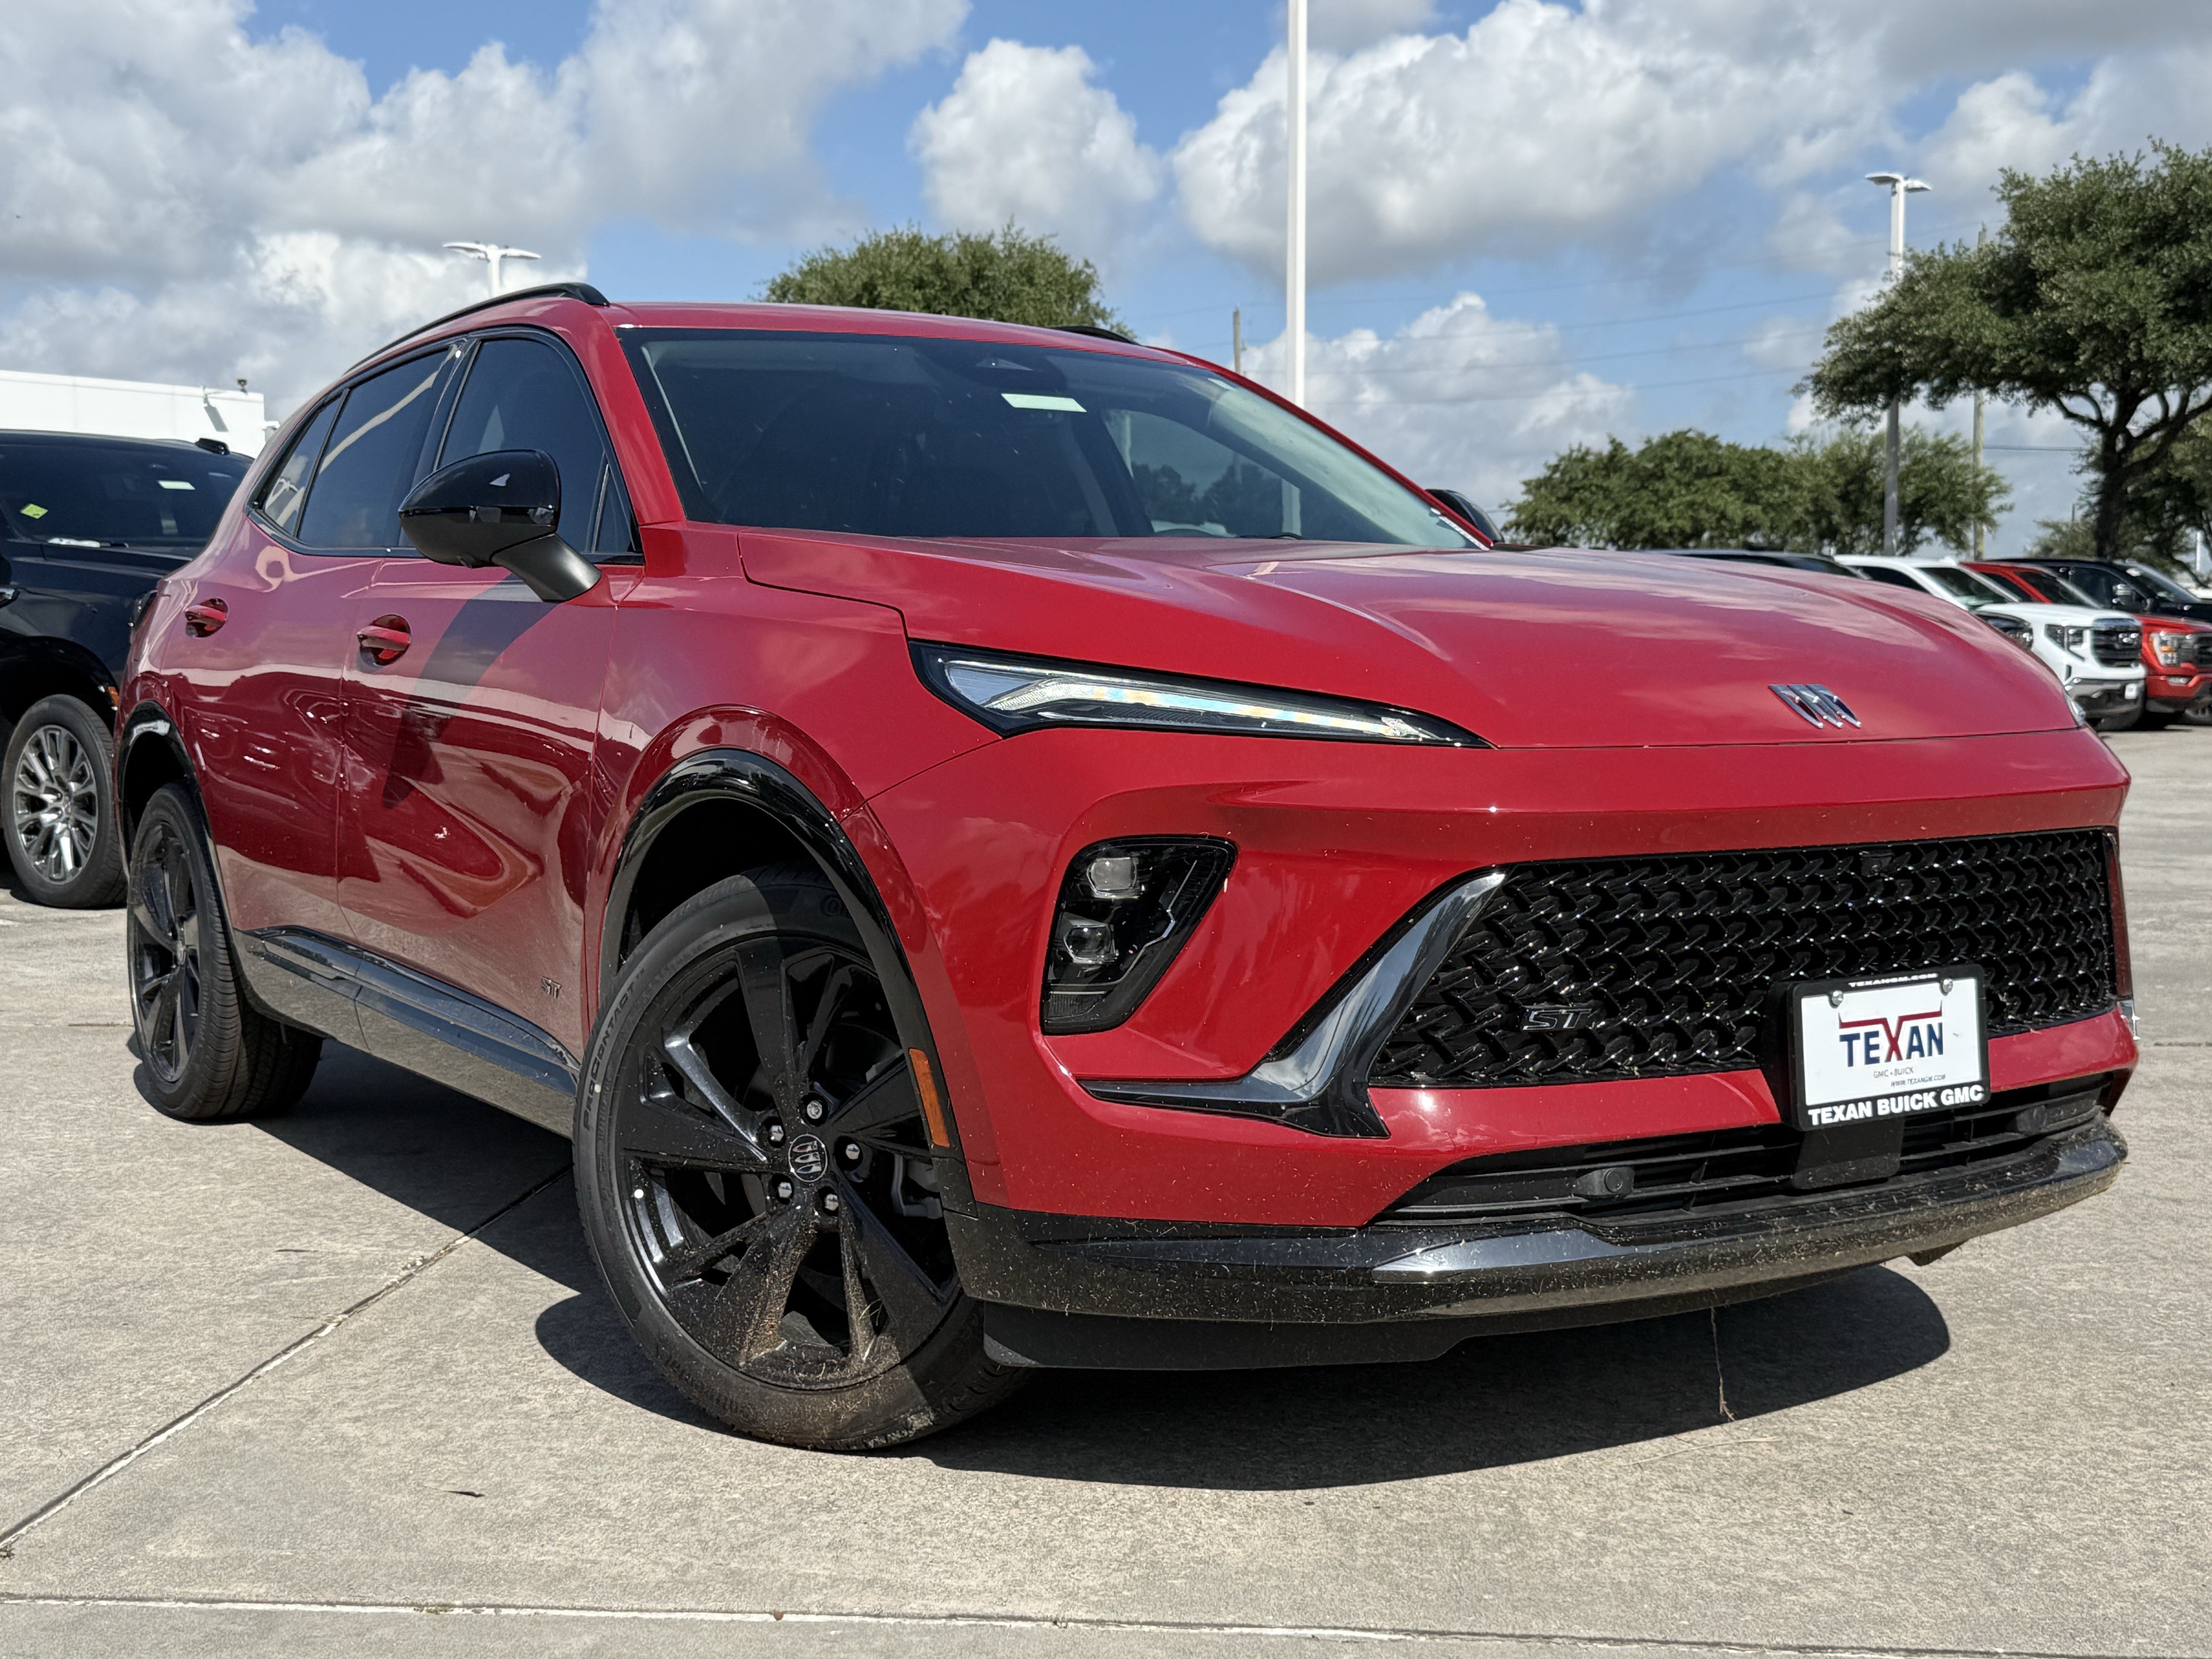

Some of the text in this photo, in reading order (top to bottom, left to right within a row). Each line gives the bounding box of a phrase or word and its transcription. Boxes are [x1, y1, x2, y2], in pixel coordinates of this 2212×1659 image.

[1848, 973, 1938, 987] TEXANGM.COM
[1523, 1008, 1592, 1030] ST
[1838, 1015, 1944, 1067] TEXAN
[1873, 1067, 1914, 1078] GMC BUICK
[1808, 1084, 1984, 1125] TEXAN BUICK GMC
